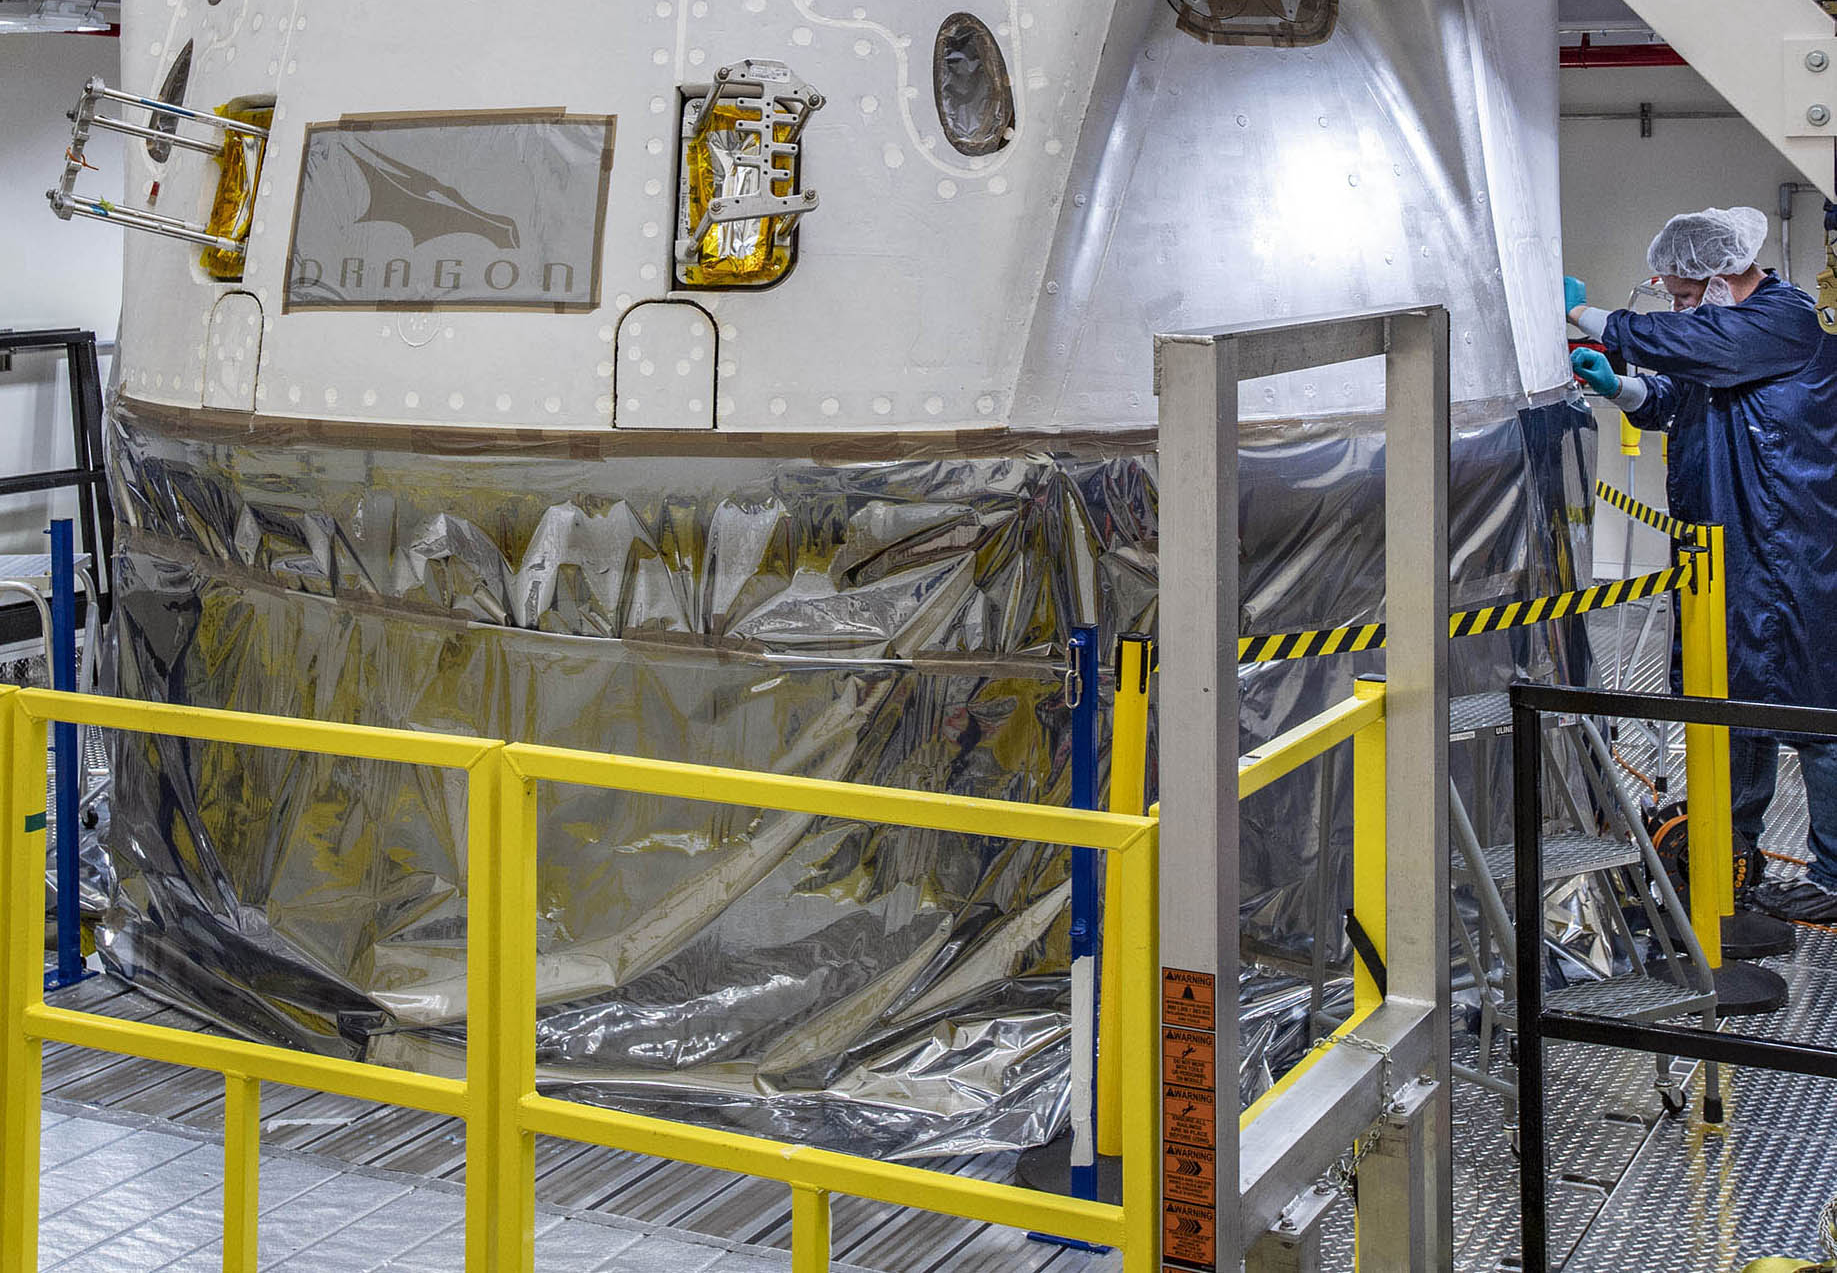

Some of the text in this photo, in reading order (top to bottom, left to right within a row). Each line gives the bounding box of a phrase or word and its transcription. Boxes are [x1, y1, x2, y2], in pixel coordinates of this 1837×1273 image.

[300, 257, 575, 293] DRAGON
[1496, 725, 1513, 734] ULINE
[1174, 973, 1211, 986] WARNING
[1174, 1030, 1212, 1045] WARNING
[1175, 1089, 1212, 1104] WARNING
[1175, 1147, 1212, 1161] WARNING
[1175, 1205, 1212, 1220] WARNING
